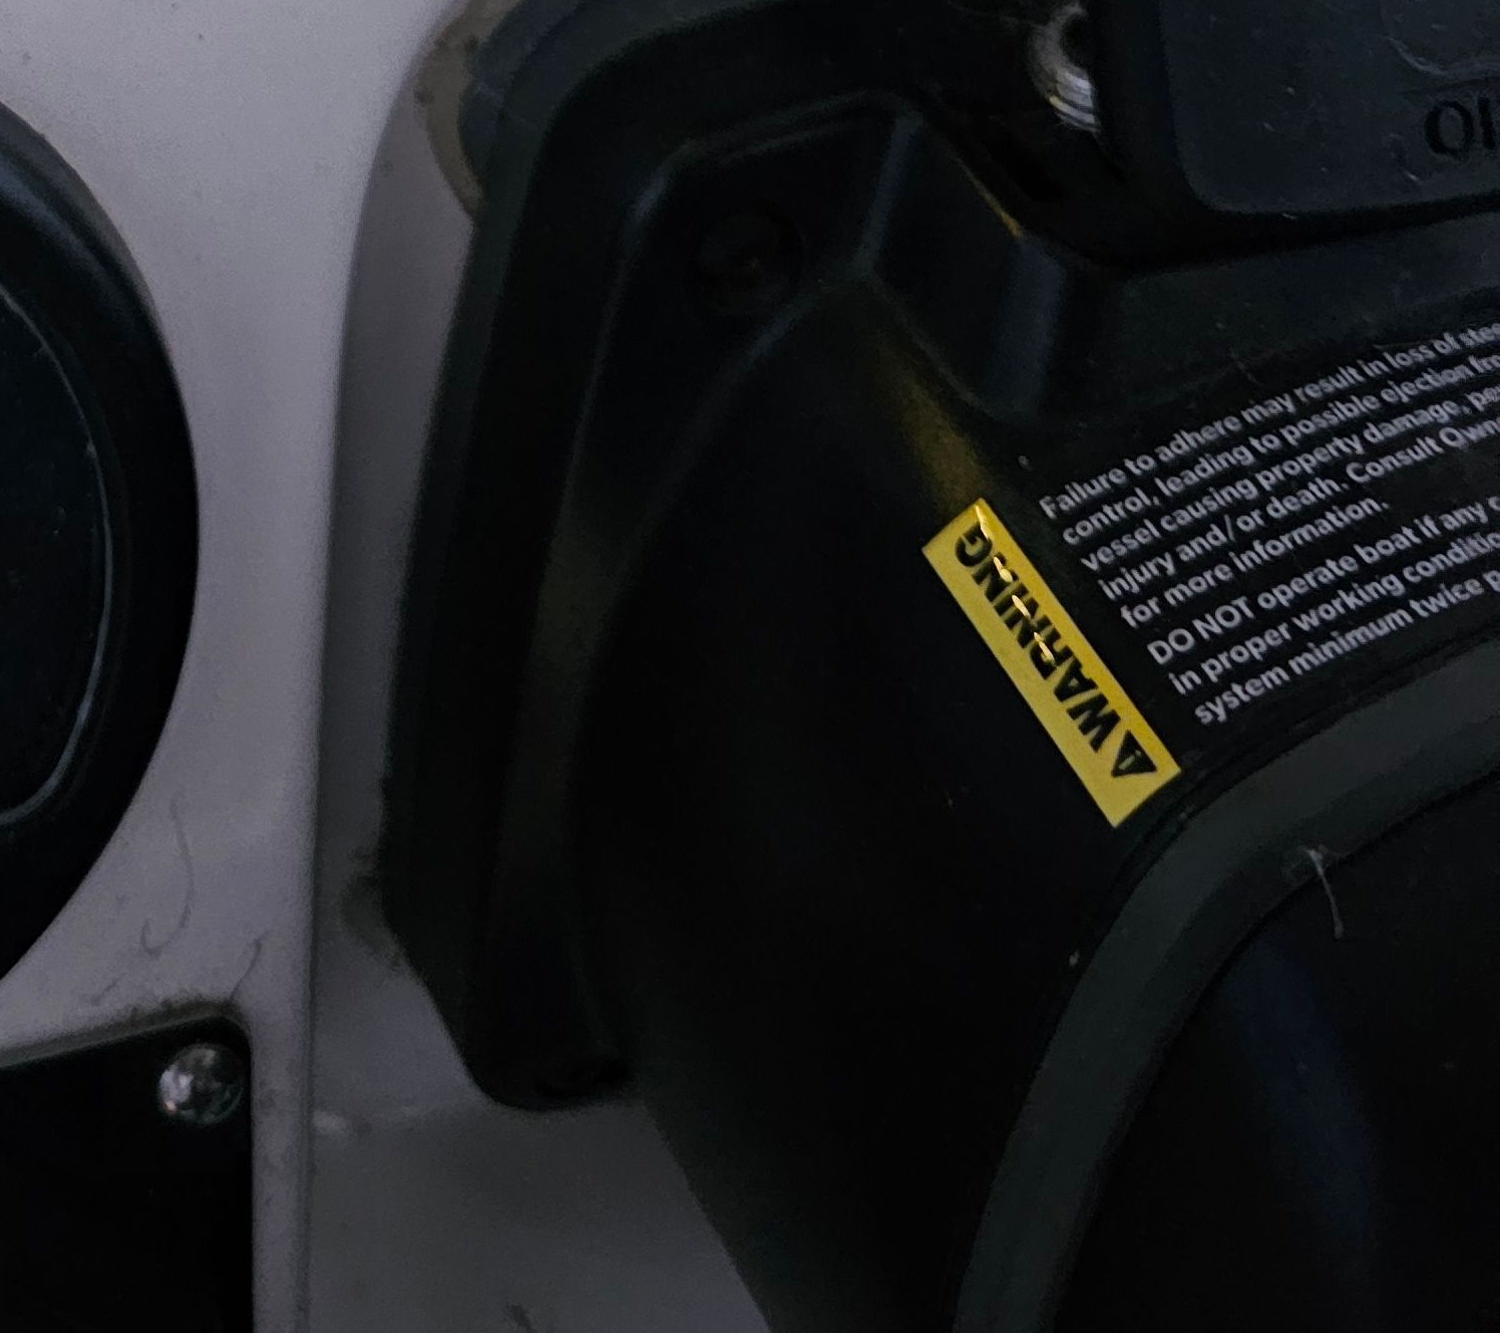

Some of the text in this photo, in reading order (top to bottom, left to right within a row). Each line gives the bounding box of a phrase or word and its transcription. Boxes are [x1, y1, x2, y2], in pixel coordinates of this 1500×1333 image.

[1039, 469, 1127, 519] Failure
[1124, 454, 1156, 477] to
[1154, 416, 1242, 462] adhere
[1241, 393, 1296, 424] may
[1294, 366, 1366, 402] result
[1356, 359, 1390, 378] in
[1383, 345, 1436, 368] loss
[1433, 332, 1461, 354] of
[1063, 487, 1161, 545] control,
[1155, 445, 1256, 497] leading
[1249, 434, 1281, 453] to
[1280, 394, 1381, 446] possible
[1381, 364, 1476, 403] ejection
[1080, 518, 1162, 571] vessel
[1160, 478, 1259, 532] causing
[1255, 434, 1365, 491] property
[1097, 551, 1176, 601] injury
[1175, 509, 1266, 562] and/or
[1266, 477, 1350, 519] death.
[1345, 436, 1445, 483] Consult
[1120, 496, 1391, 629] for more information.
[1146, 628, 1195, 665] DO
[1192, 596, 1256, 641] NOT
[1257, 554, 1359, 610] operate
[1353, 525, 1422, 565] boat
[1413, 514, 1442, 539] if
[1438, 501, 1489, 531] any
[955, 523, 1122, 754] WARNING
[1168, 669, 1202, 697] in
[1200, 621, 1293, 683] proper
[1292, 572, 1407, 632] working
[1194, 663, 1291, 726] system
[1288, 606, 1414, 676] minimum
[1409, 578, 1485, 618] twice
